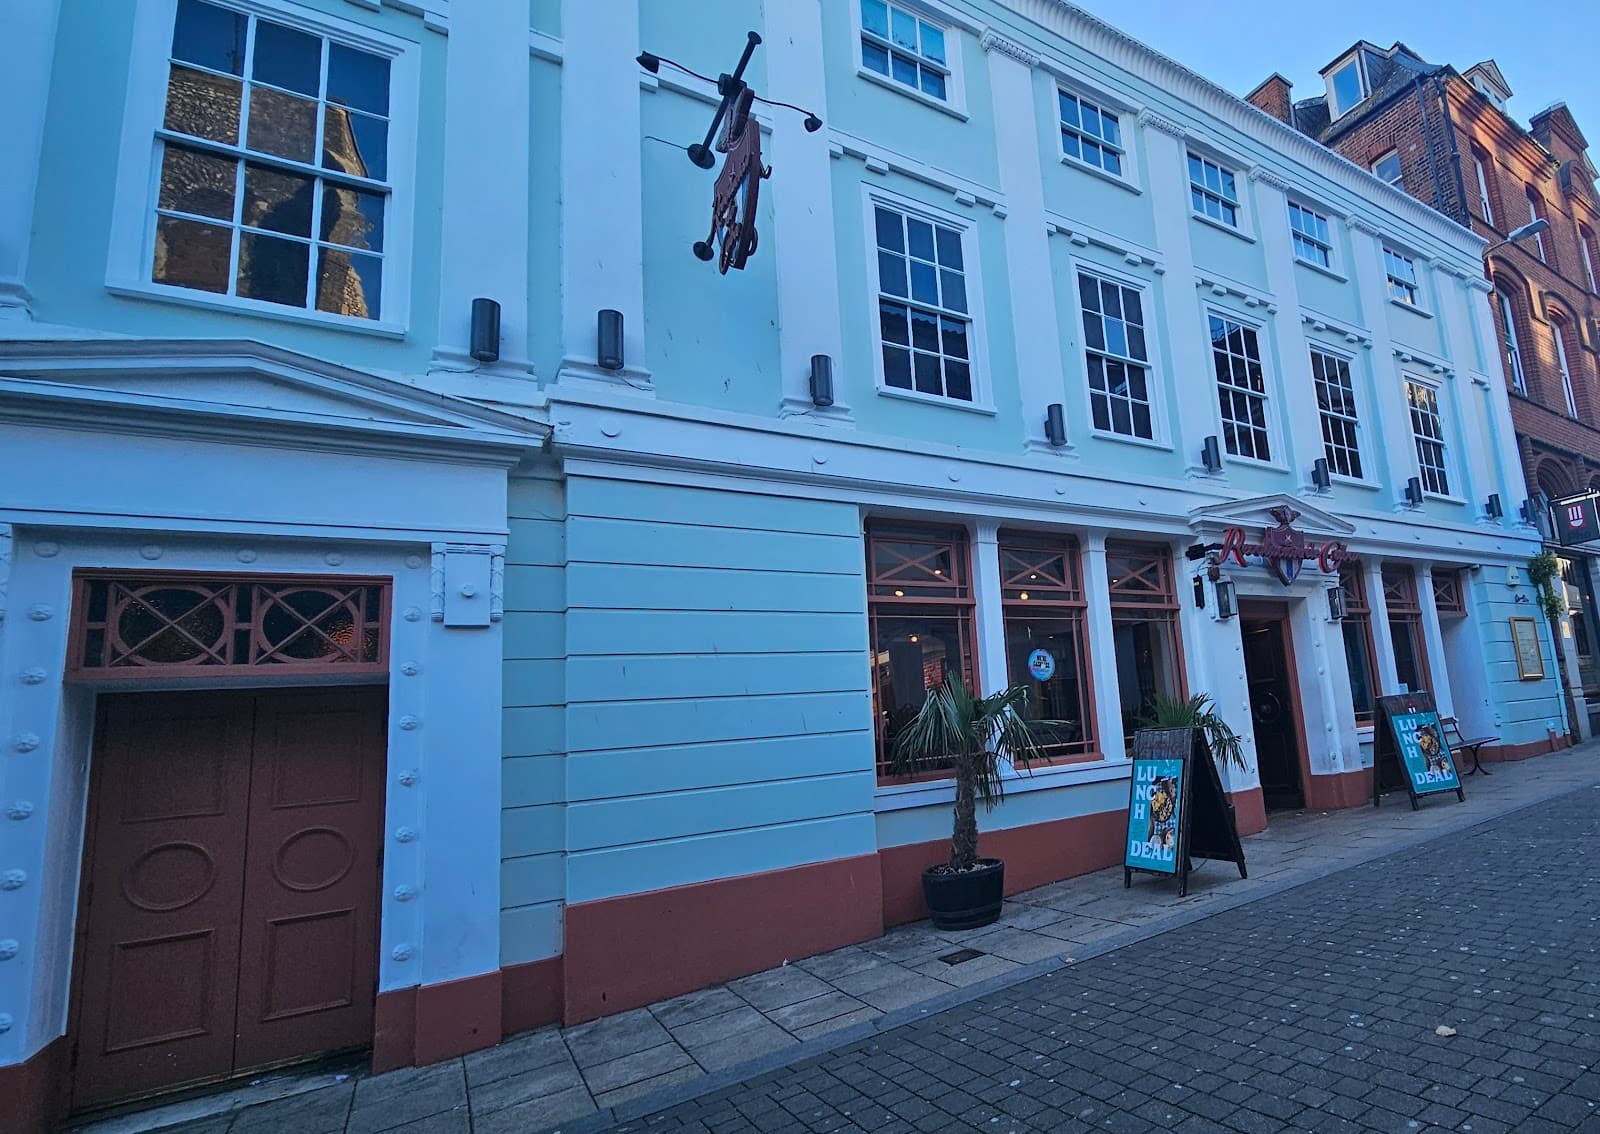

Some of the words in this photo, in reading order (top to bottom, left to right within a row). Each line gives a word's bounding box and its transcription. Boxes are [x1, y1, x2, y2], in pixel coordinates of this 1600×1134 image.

[1136, 765, 1157, 782] LU
[1414, 769, 1453, 785] DEAL
[1134, 803, 1146, 819] H
[1130, 840, 1173, 861] DEAL
